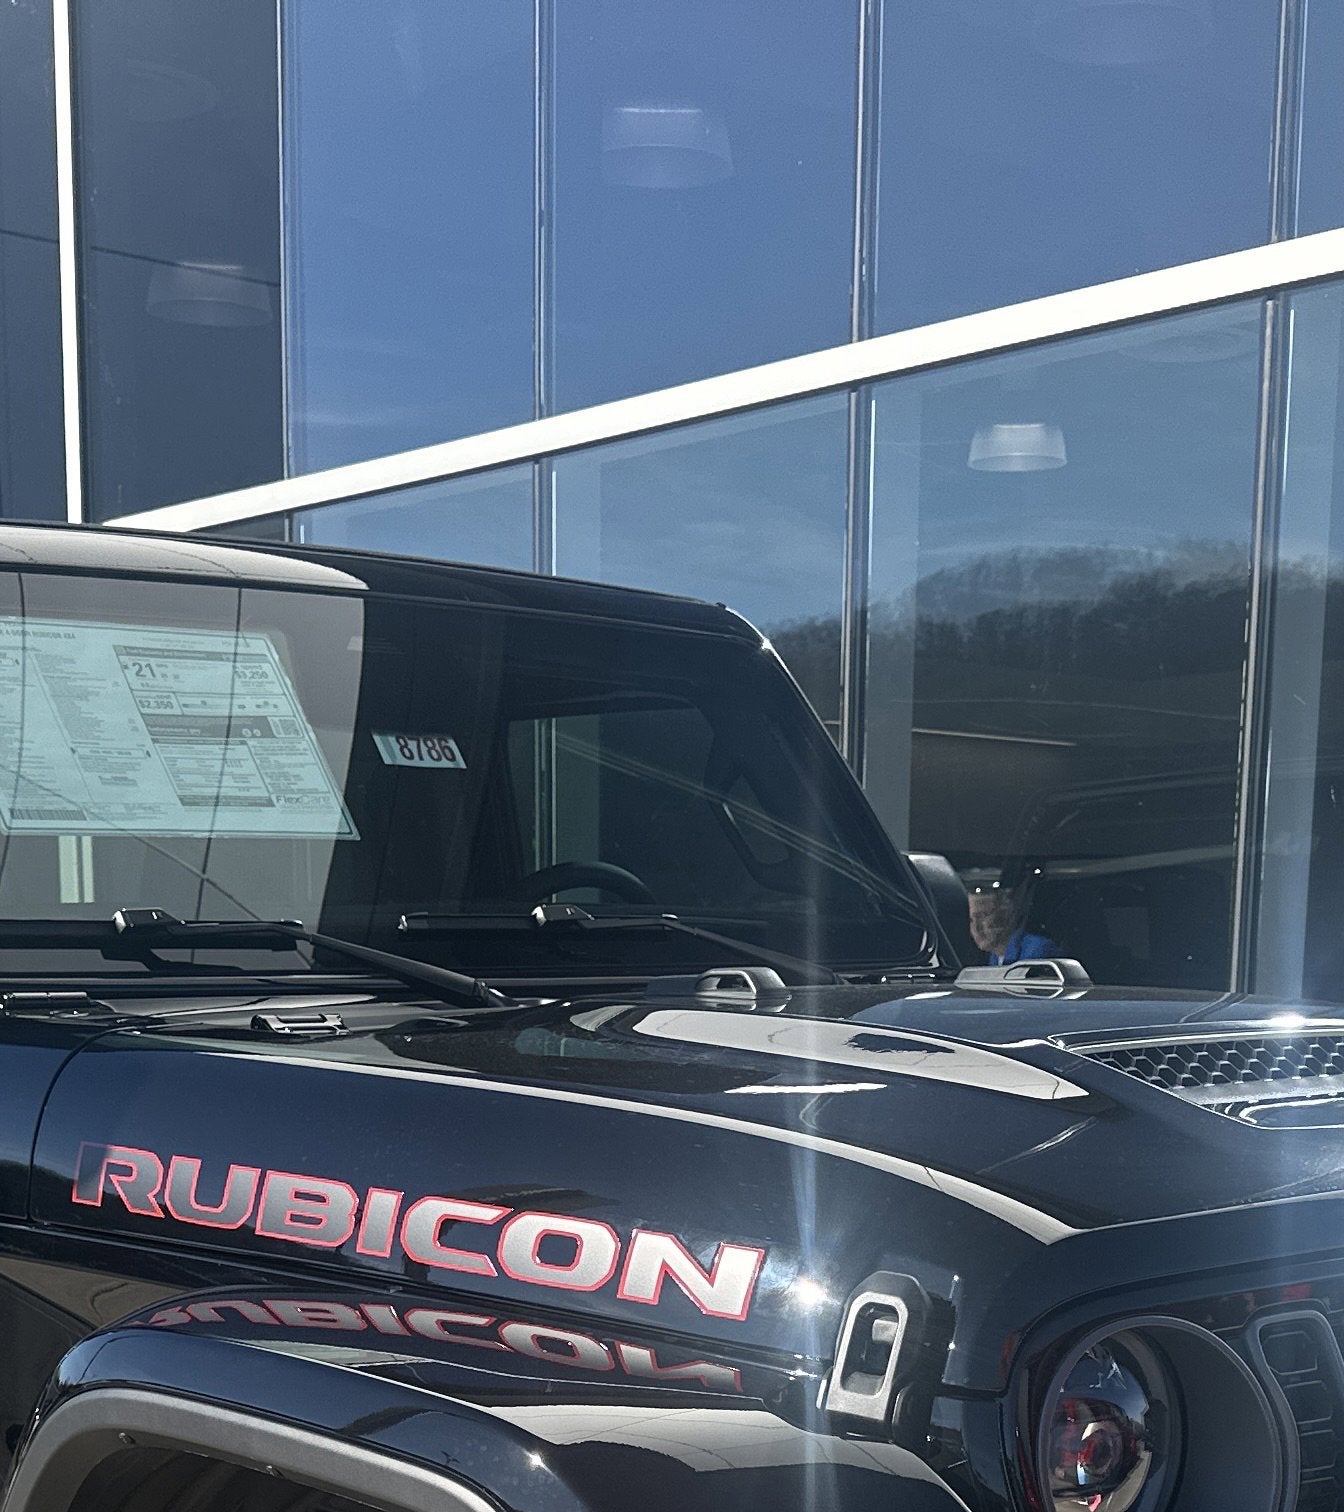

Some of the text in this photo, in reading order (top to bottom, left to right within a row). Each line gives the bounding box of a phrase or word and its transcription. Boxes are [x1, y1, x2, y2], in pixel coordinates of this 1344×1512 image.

[132, 662, 155, 678] 21
[396, 735, 457, 762] 8786
[72, 1142, 765, 1322] RUBICON
